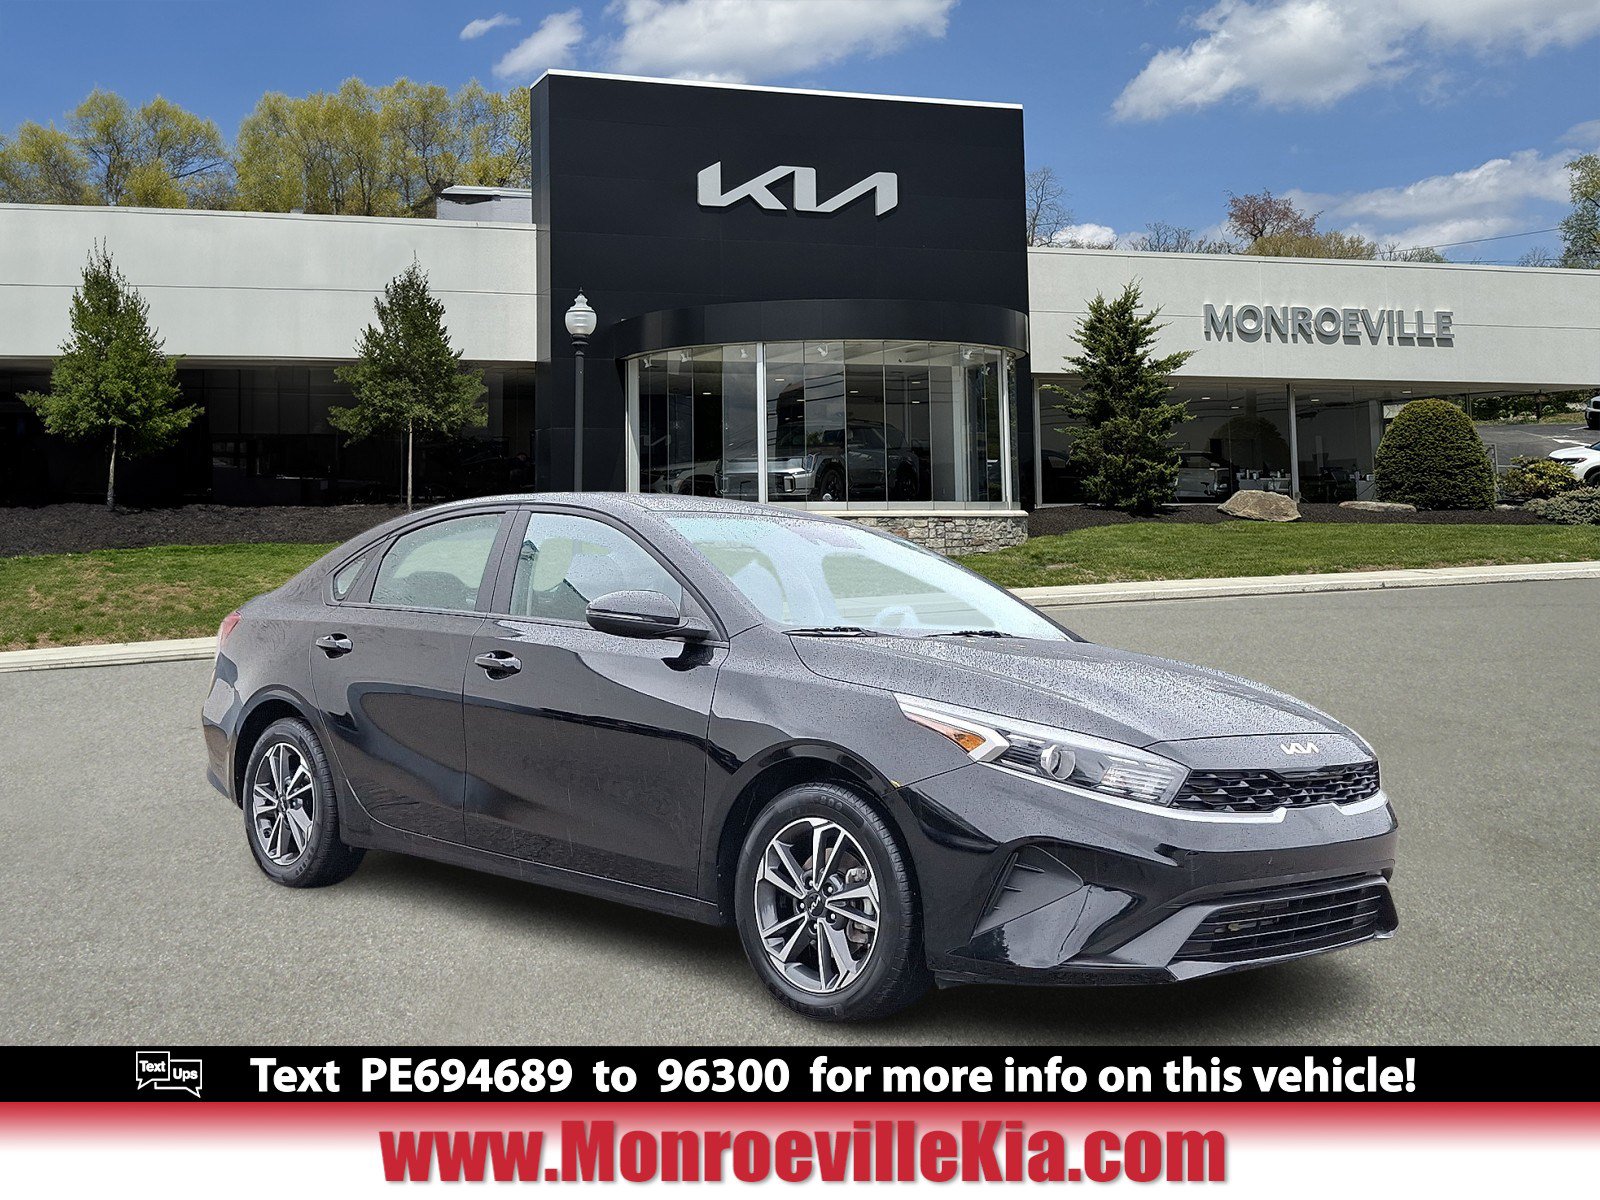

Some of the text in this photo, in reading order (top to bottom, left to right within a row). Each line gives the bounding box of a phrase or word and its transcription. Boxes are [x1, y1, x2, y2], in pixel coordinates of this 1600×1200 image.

[697, 161, 898, 217] KIA
[1203, 303, 1455, 347] MONROEVILLE
[1280, 741, 1320, 755] KIA
